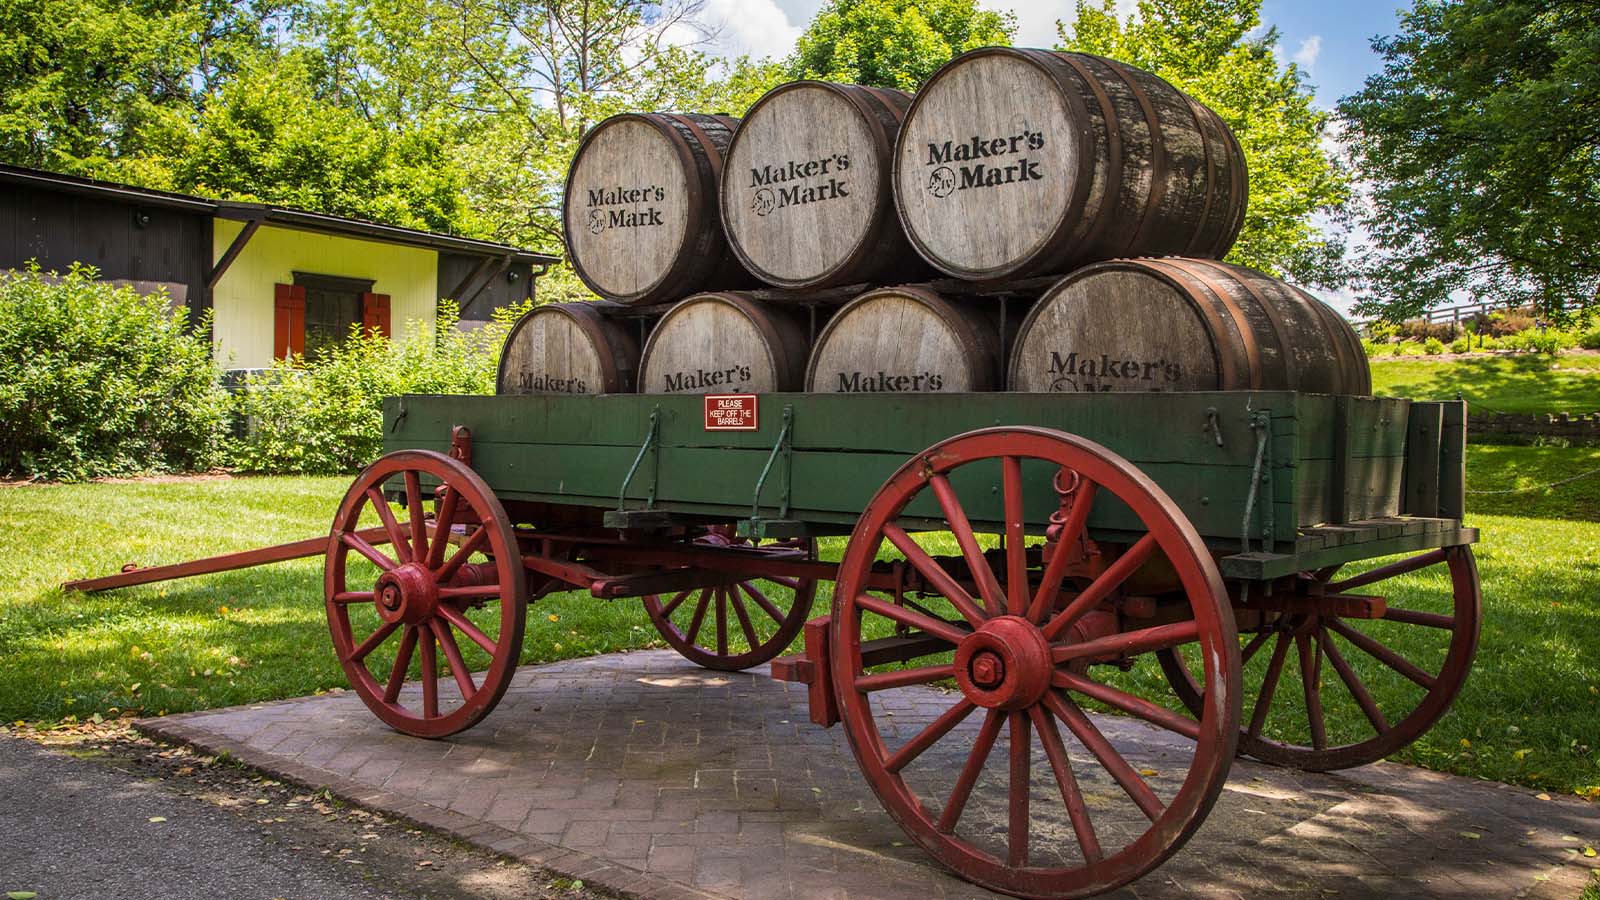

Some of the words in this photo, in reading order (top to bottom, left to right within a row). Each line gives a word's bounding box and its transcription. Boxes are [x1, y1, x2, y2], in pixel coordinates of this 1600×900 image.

[926, 131, 1045, 165] Maker's
[749, 153, 850, 188] Maker's
[958, 158, 1043, 190] Mark
[586, 185, 665, 207] Maker's
[777, 179, 850, 208] Mark
[608, 207, 664, 229] Mark
[663, 364, 752, 393] Maker's
[1047, 351, 1182, 382] Maker's
[518, 372, 586, 394] Maker's
[837, 371, 943, 393] Maker's
[709, 409, 725, 418] KEEP
[726, 409, 738, 418] OFF
[740, 409, 752, 418] THE
[718, 399, 743, 408] PLEASE
